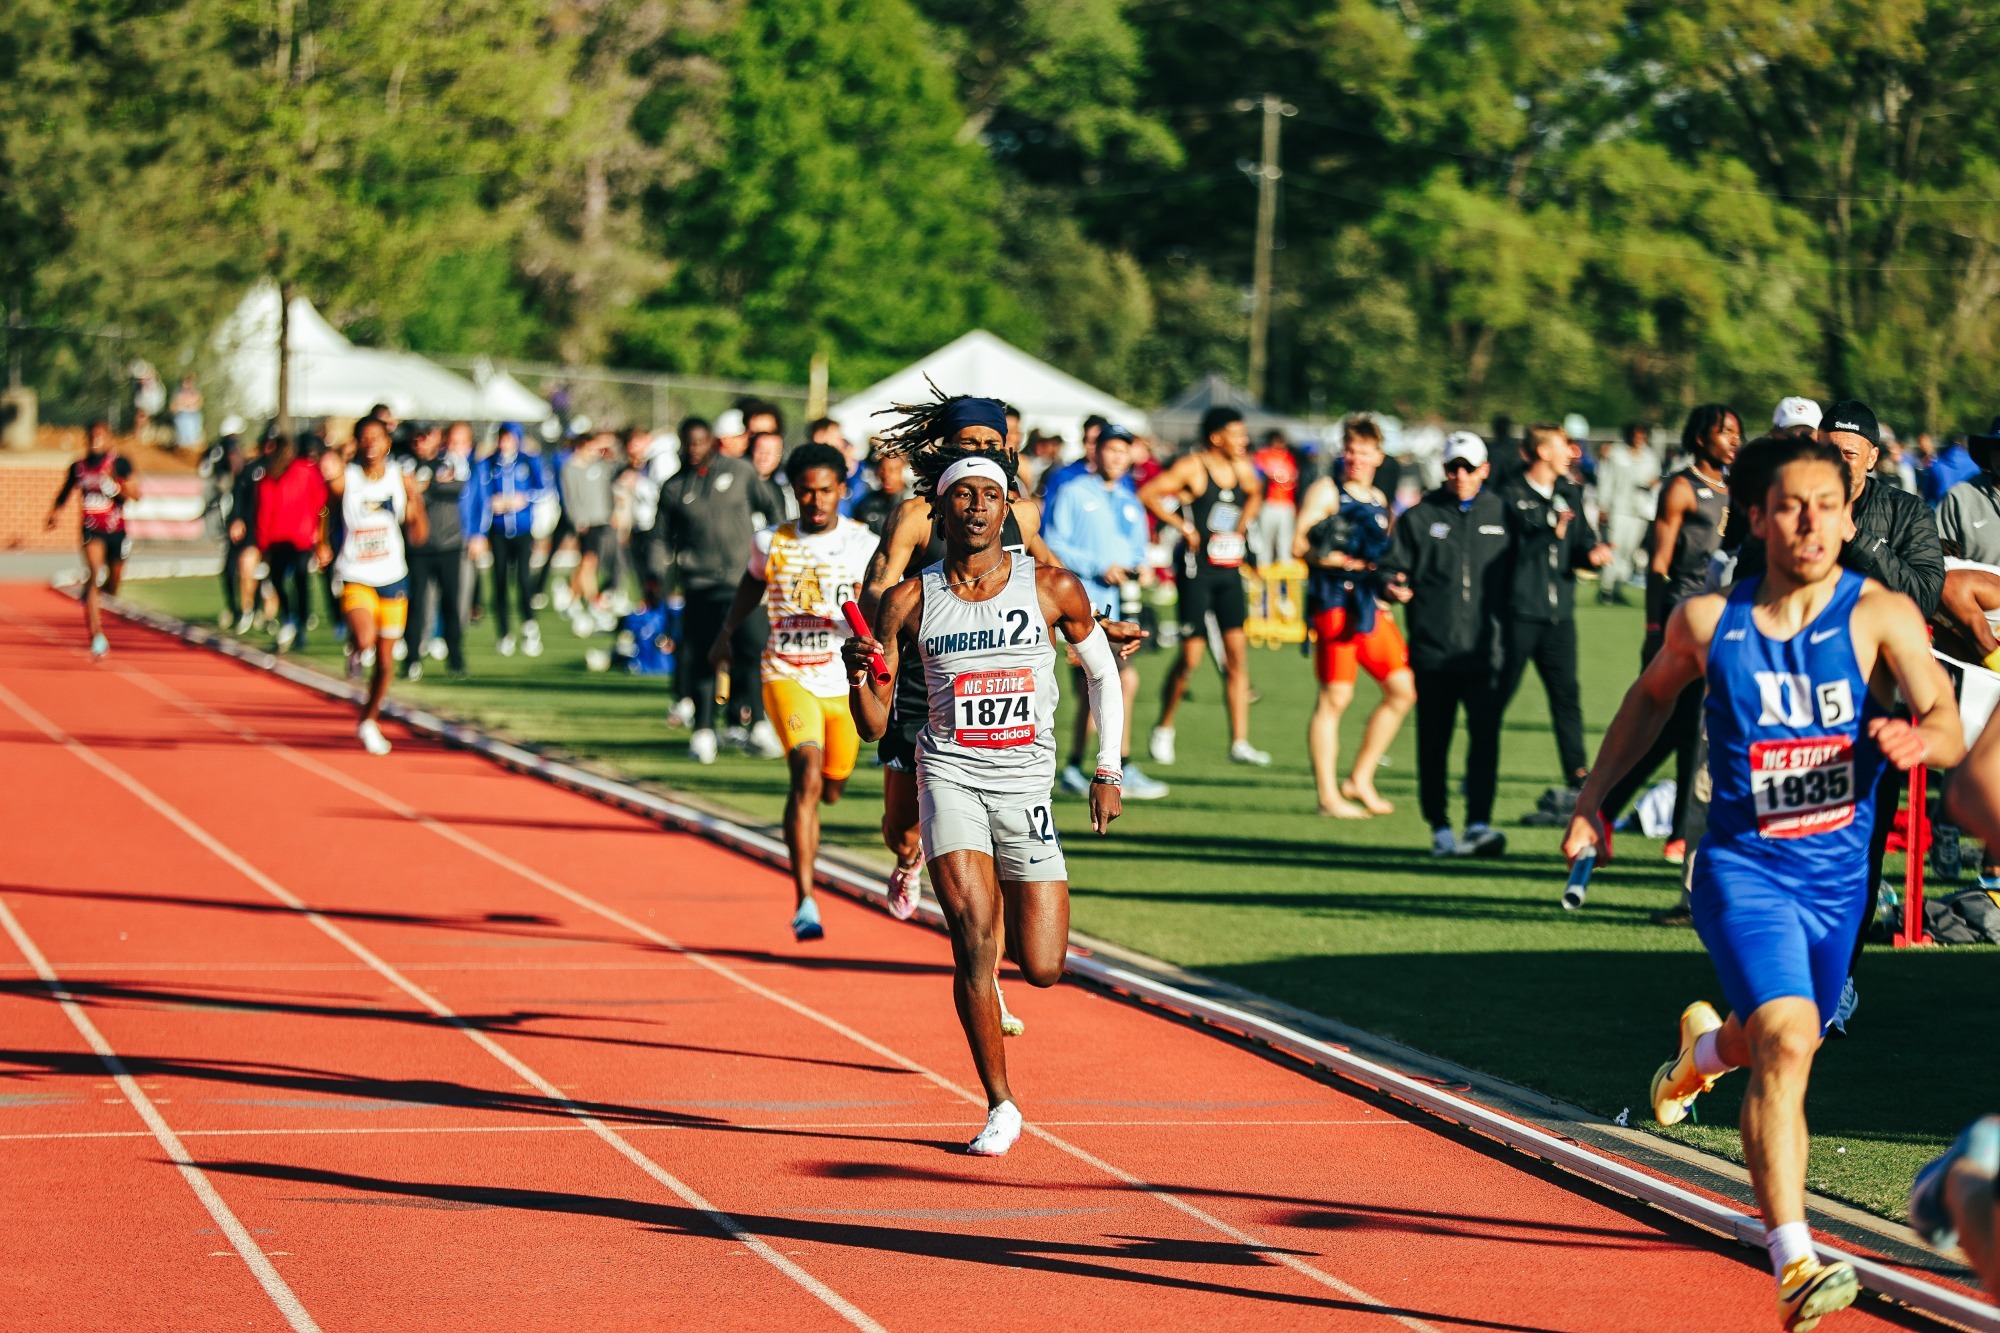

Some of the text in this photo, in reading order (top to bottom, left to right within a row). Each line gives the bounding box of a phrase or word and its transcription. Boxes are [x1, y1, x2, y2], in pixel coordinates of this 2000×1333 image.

[925, 625, 1041, 658] CUMBERLA
[1006, 609, 1032, 646] 2
[964, 677, 1025, 695] NC STATE
[961, 696, 1030, 726] 1874
[1823, 687, 1841, 721] 5
[990, 727, 1031, 740] adidas
[1762, 747, 1788, 769] NC
[1762, 766, 1849, 810] 1935
[1034, 805, 1053, 840] 2
